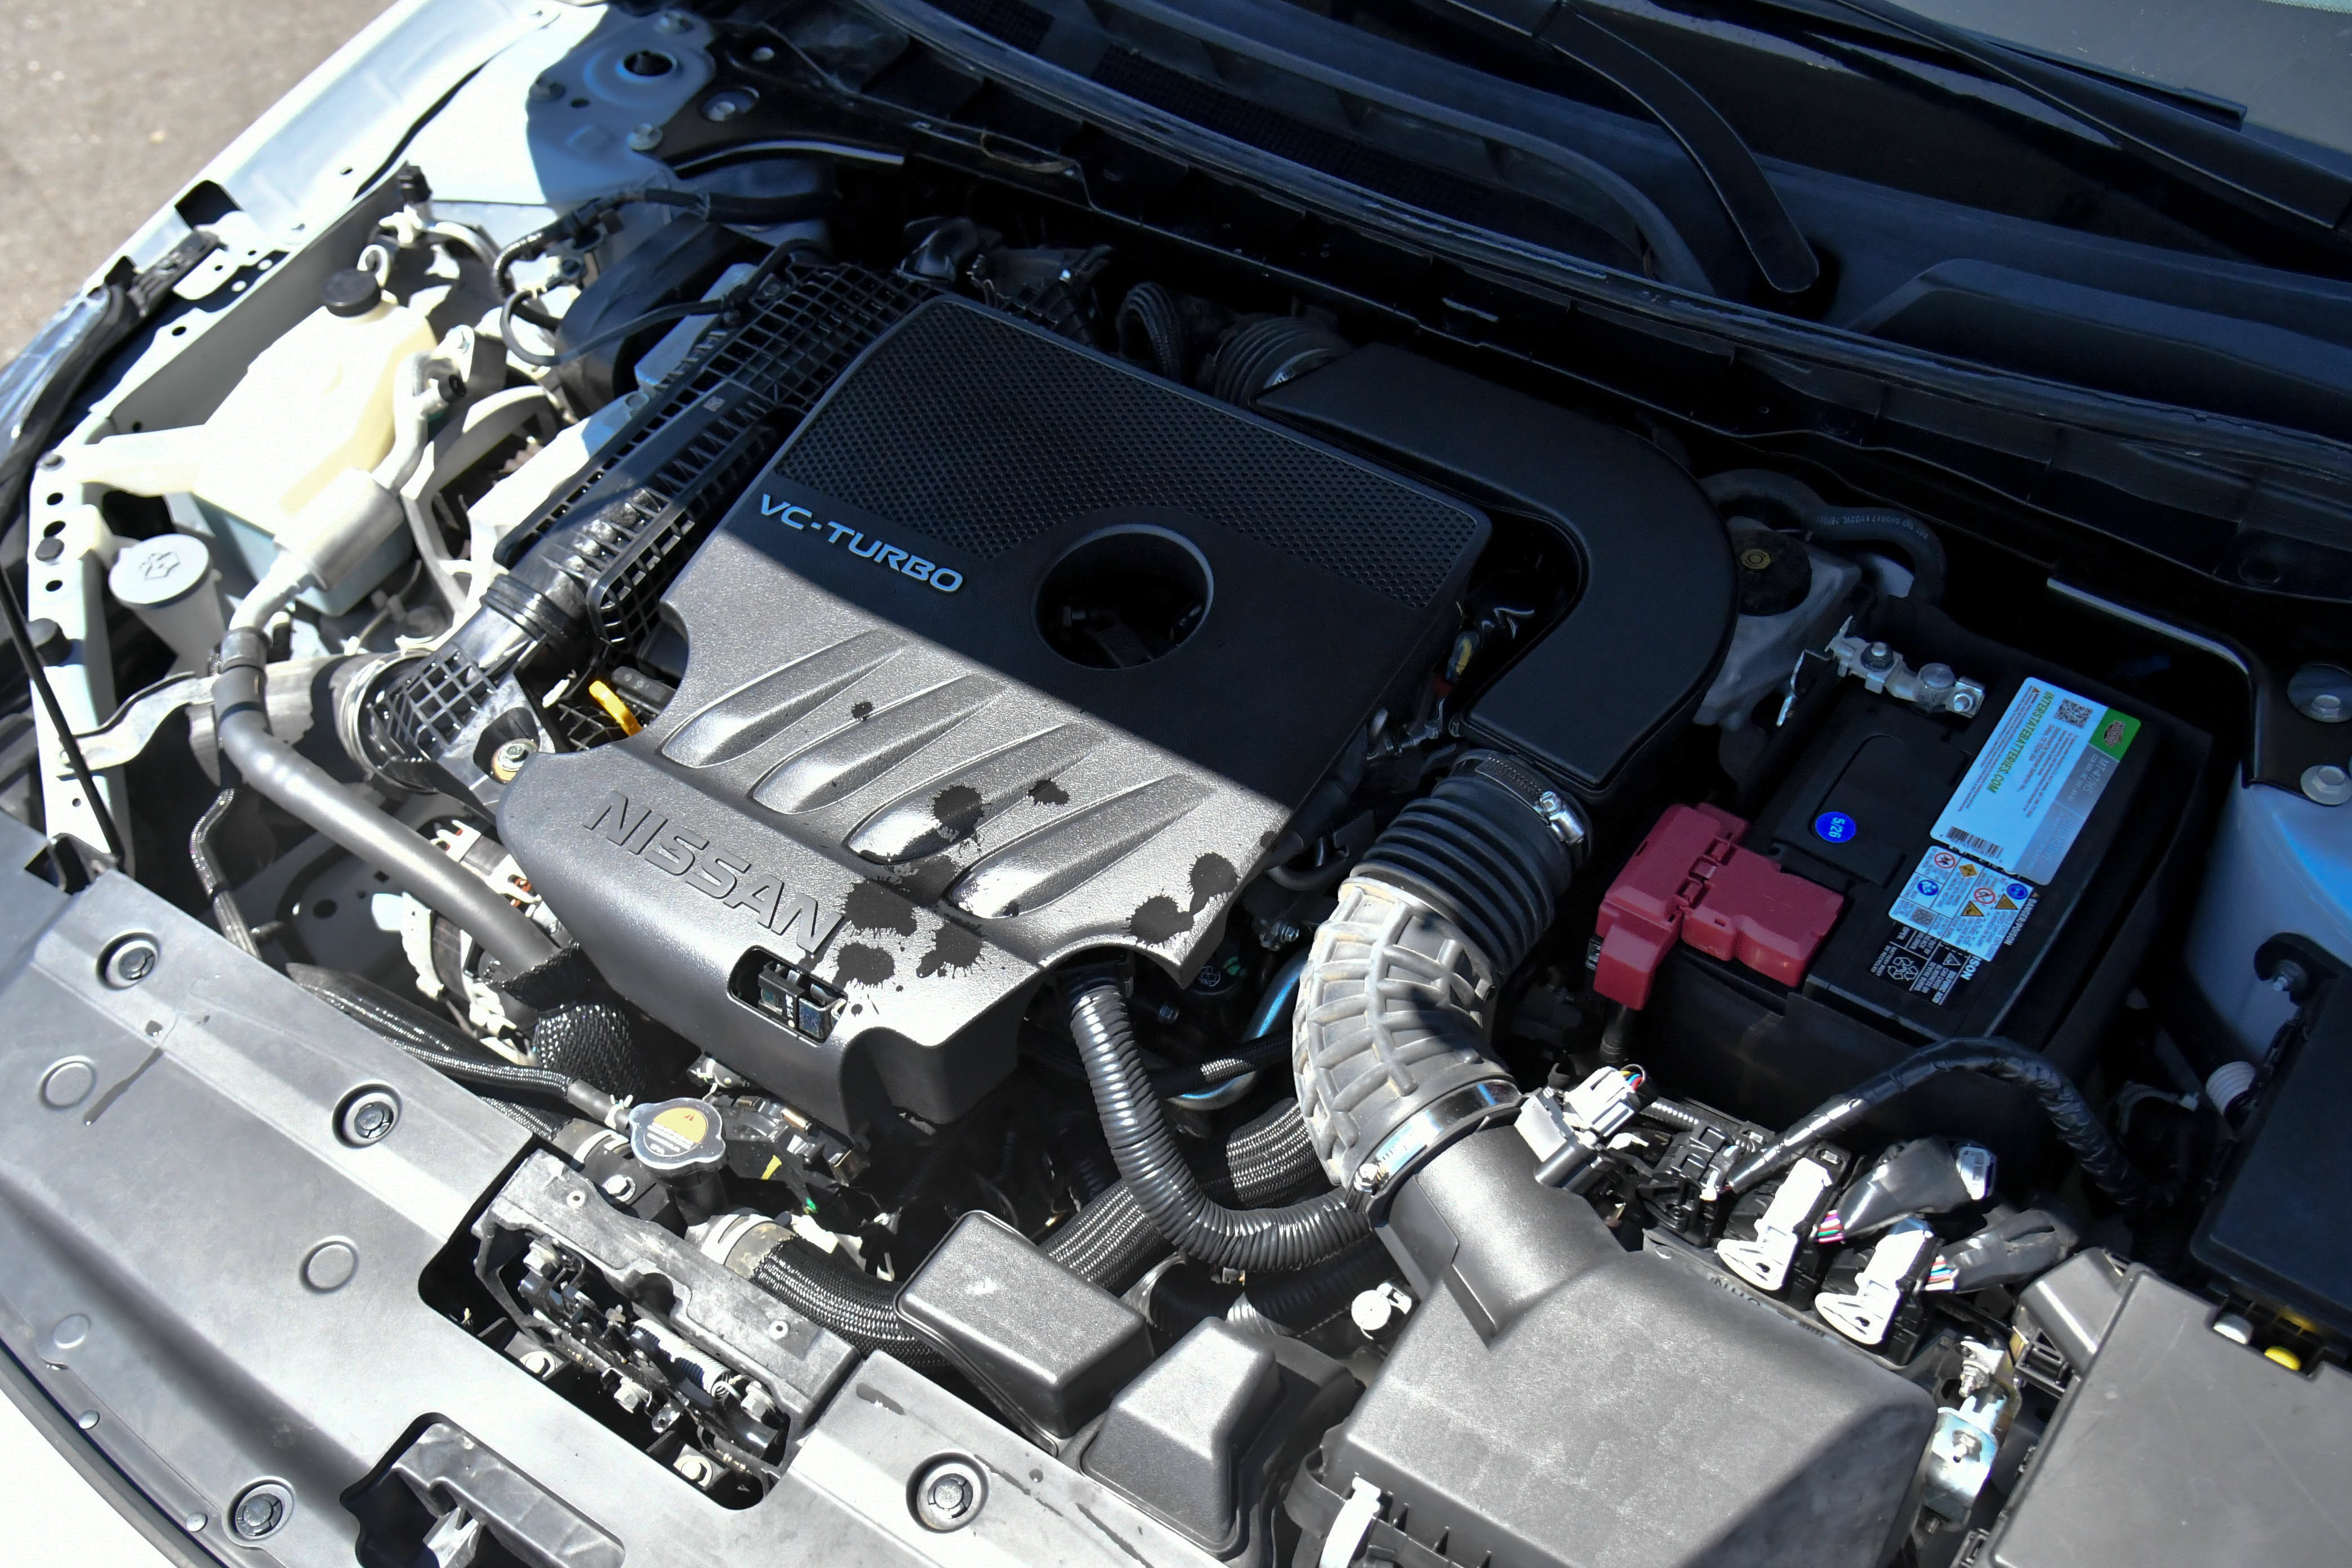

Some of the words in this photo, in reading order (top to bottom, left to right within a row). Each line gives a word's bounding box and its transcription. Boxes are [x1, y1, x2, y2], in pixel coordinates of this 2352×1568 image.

[760, 493, 964, 593] VC-TURBO
[1985, 691, 2055, 794] INTERSTATEBATTERIES.COM
[1828, 817, 1846, 839] 5/26
[582, 790, 845, 955] NISSAN
[2003, 897, 2038, 946] DANGER/POISON
[1959, 955, 1983, 981] ISON
